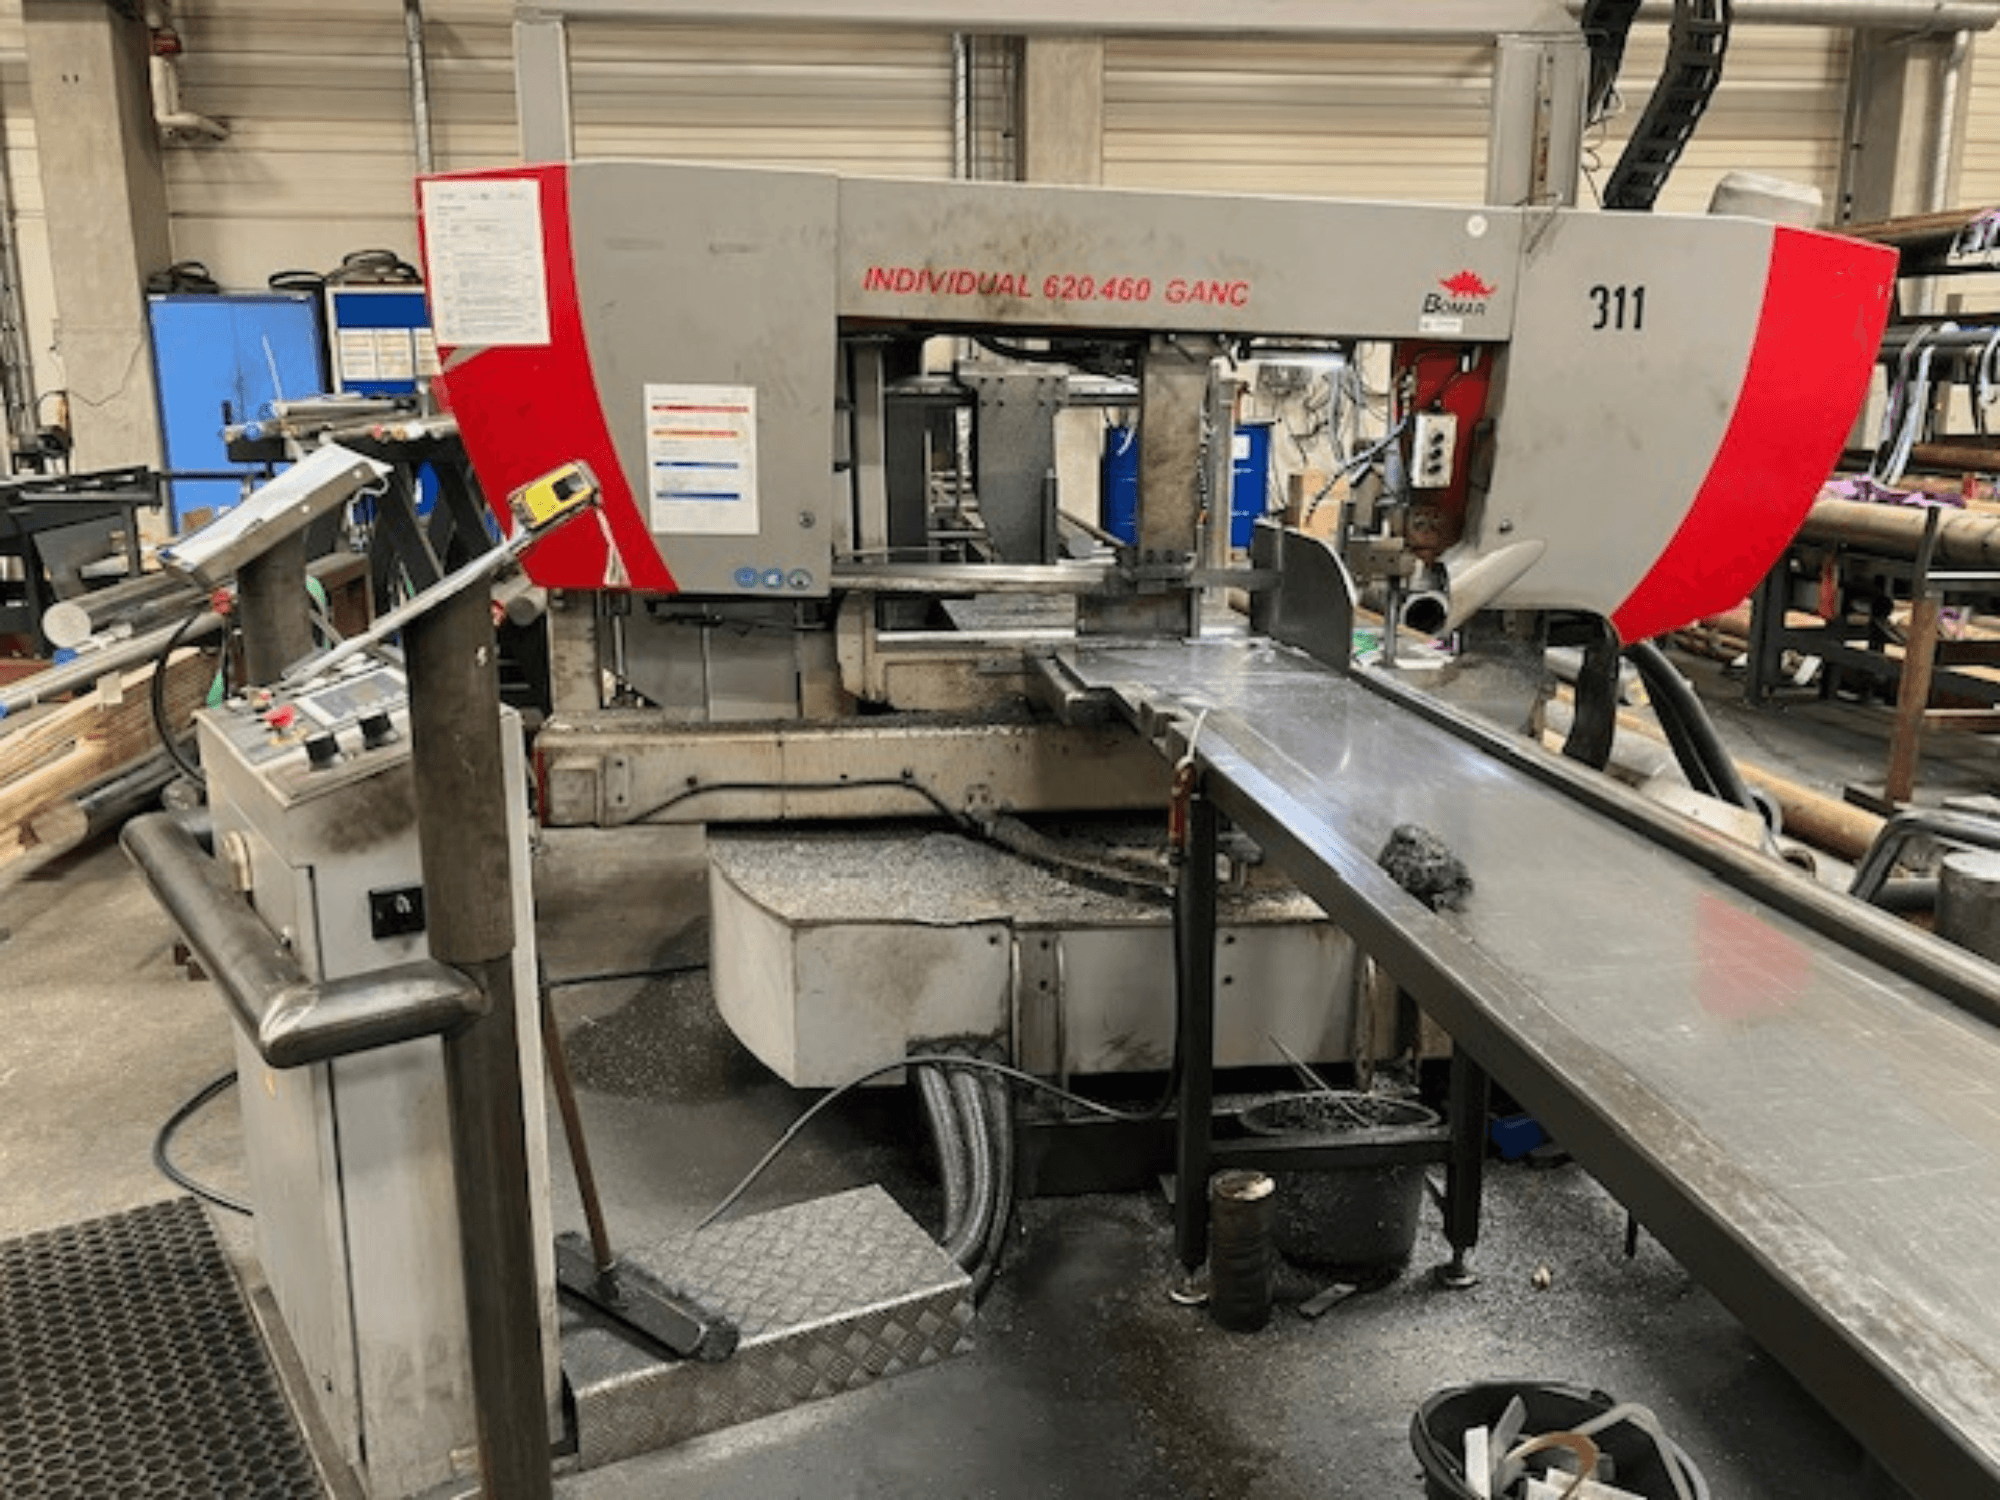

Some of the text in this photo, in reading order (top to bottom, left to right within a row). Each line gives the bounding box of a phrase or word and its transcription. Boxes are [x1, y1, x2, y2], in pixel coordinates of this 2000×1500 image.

[862, 266, 1250, 308] INDIVIDUAL 620.460 GANC
[1589, 285, 1645, 331] 311
